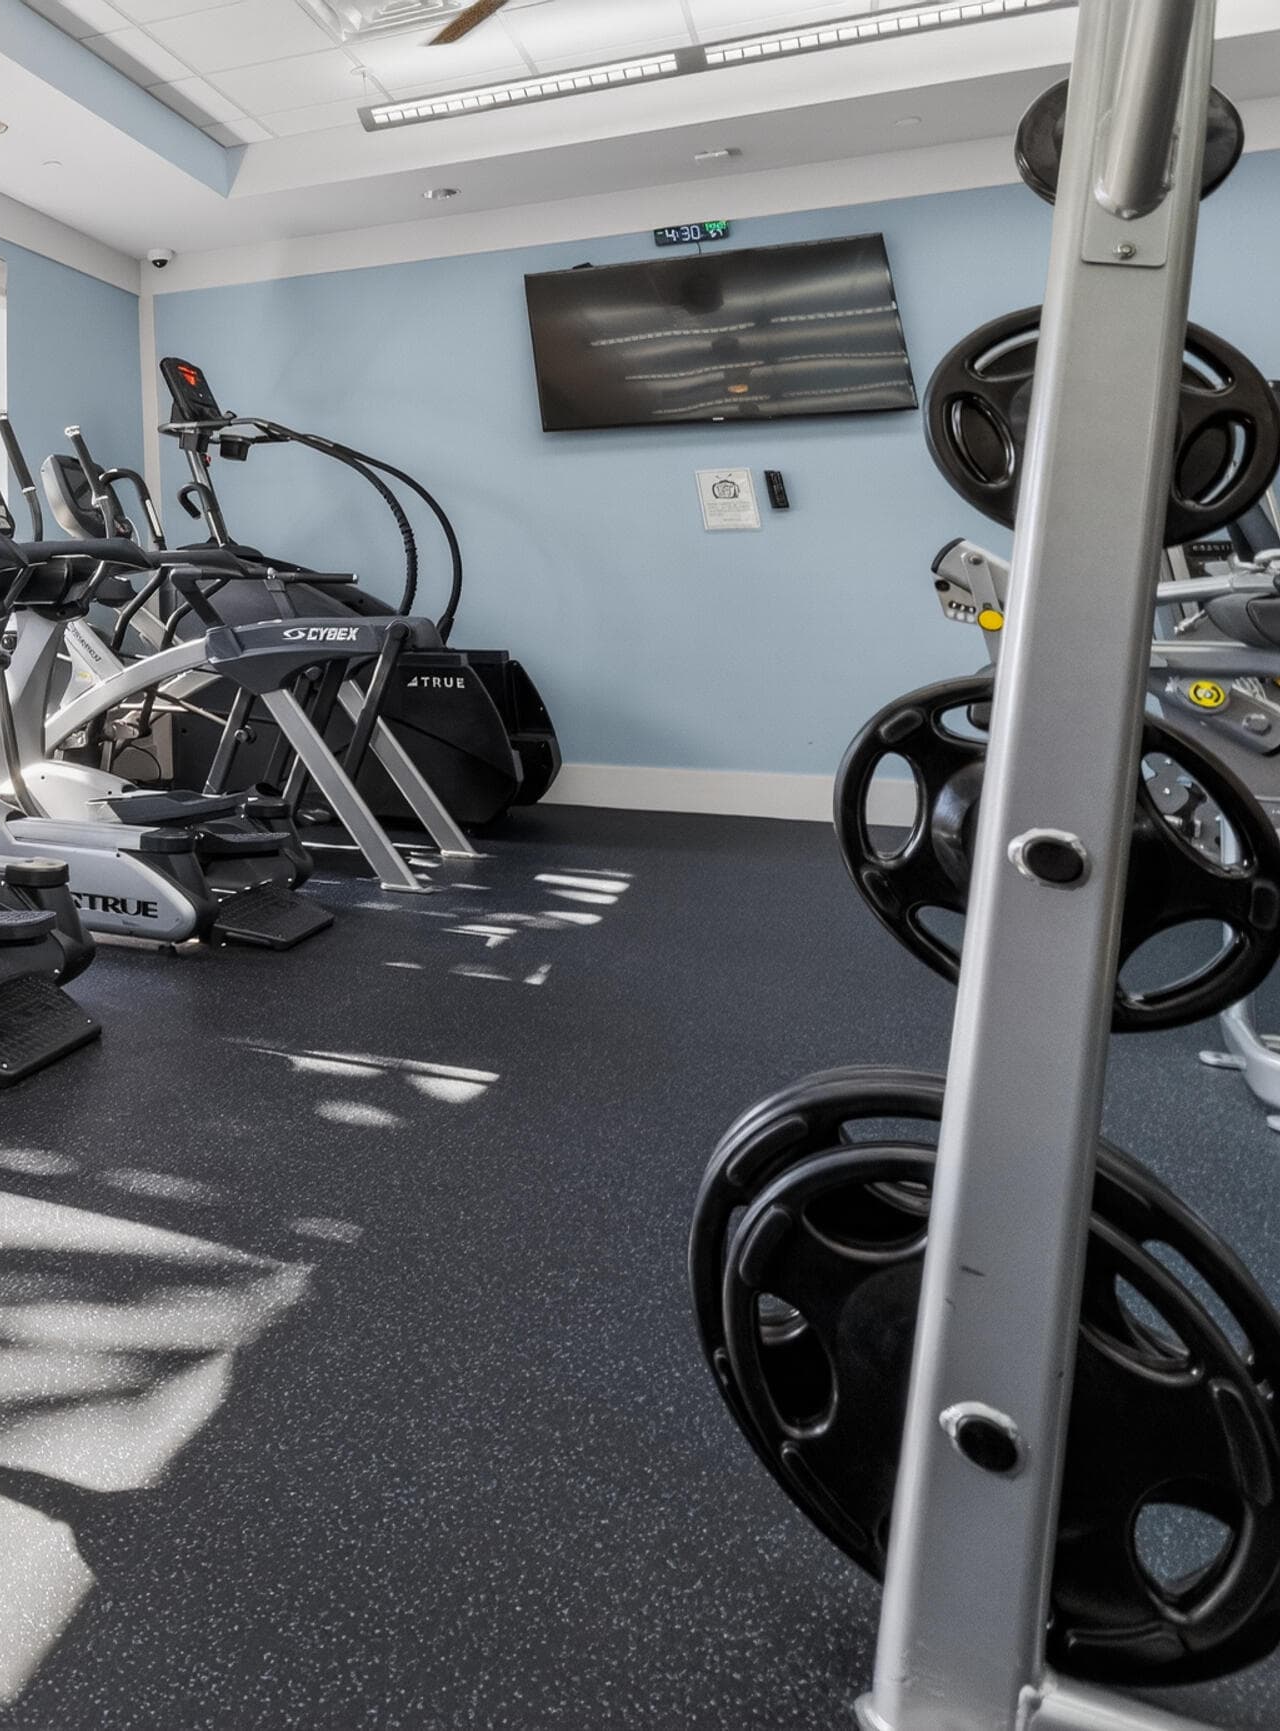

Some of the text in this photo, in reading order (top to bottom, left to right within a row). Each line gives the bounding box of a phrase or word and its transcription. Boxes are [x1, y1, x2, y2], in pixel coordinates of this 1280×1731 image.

[306, 627, 359, 641] CYBEX
[421, 677, 465, 688] TRUE
[82, 893, 159, 919] TRUE
